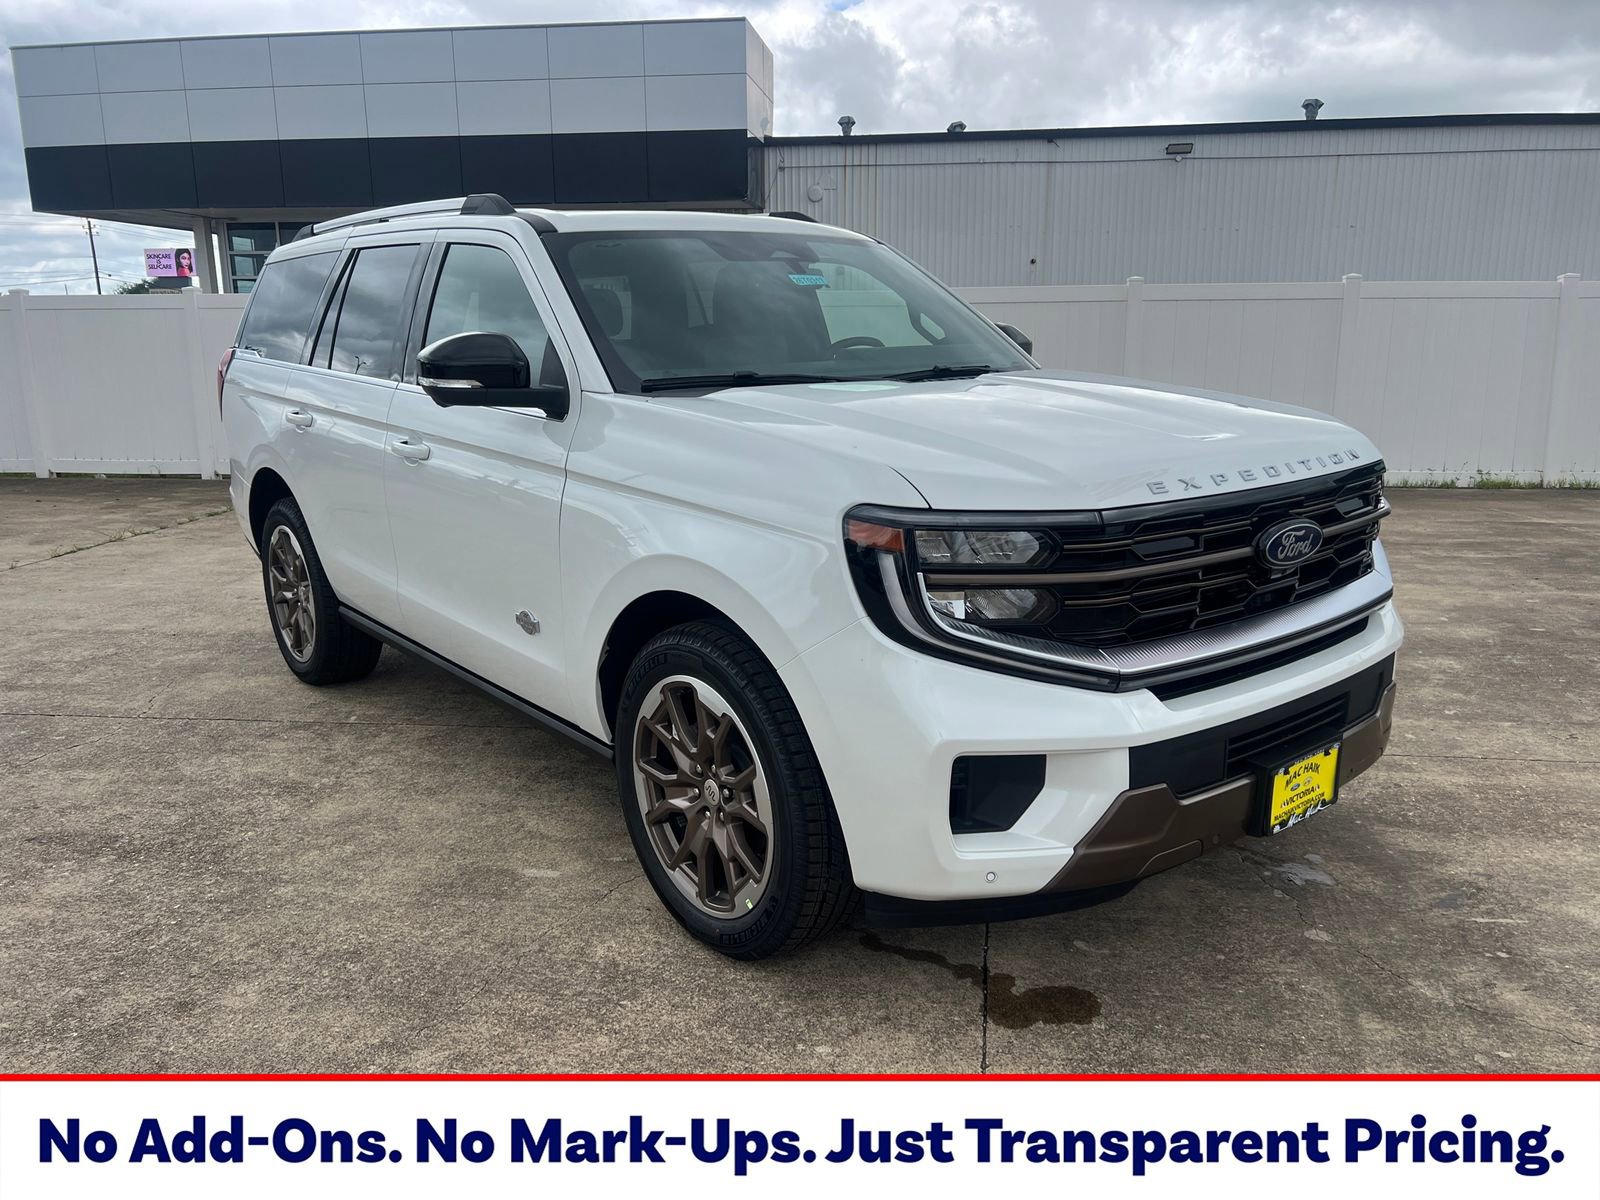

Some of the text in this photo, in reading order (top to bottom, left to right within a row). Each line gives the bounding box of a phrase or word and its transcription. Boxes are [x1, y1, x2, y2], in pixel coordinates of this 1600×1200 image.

[1146, 449, 1361, 495] EXPEDITION
[1278, 529, 1314, 560] Ford
[1284, 761, 1321, 790] MAC HAIK
